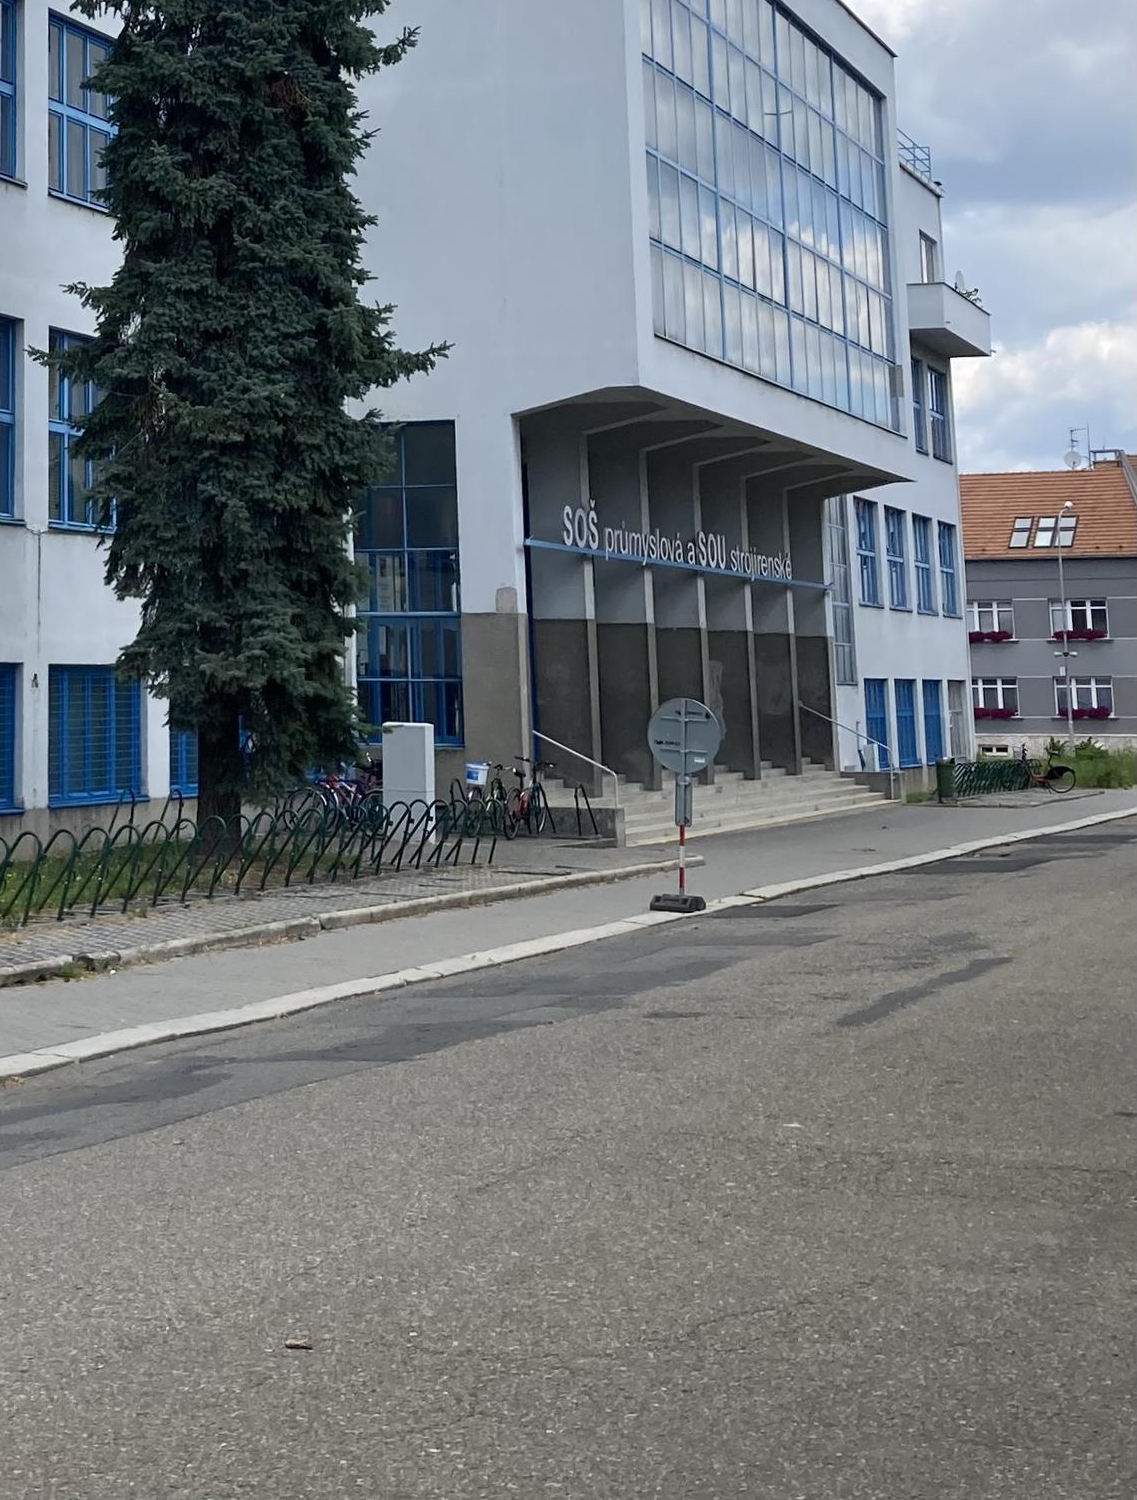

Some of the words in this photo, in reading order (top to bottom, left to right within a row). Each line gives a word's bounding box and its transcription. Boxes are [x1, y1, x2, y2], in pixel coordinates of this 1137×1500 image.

[563, 499, 599, 550] SOŠ
[687, 542, 696, 565] a
[698, 531, 726, 570] SOU
[730, 545, 792, 581] strojírenské
